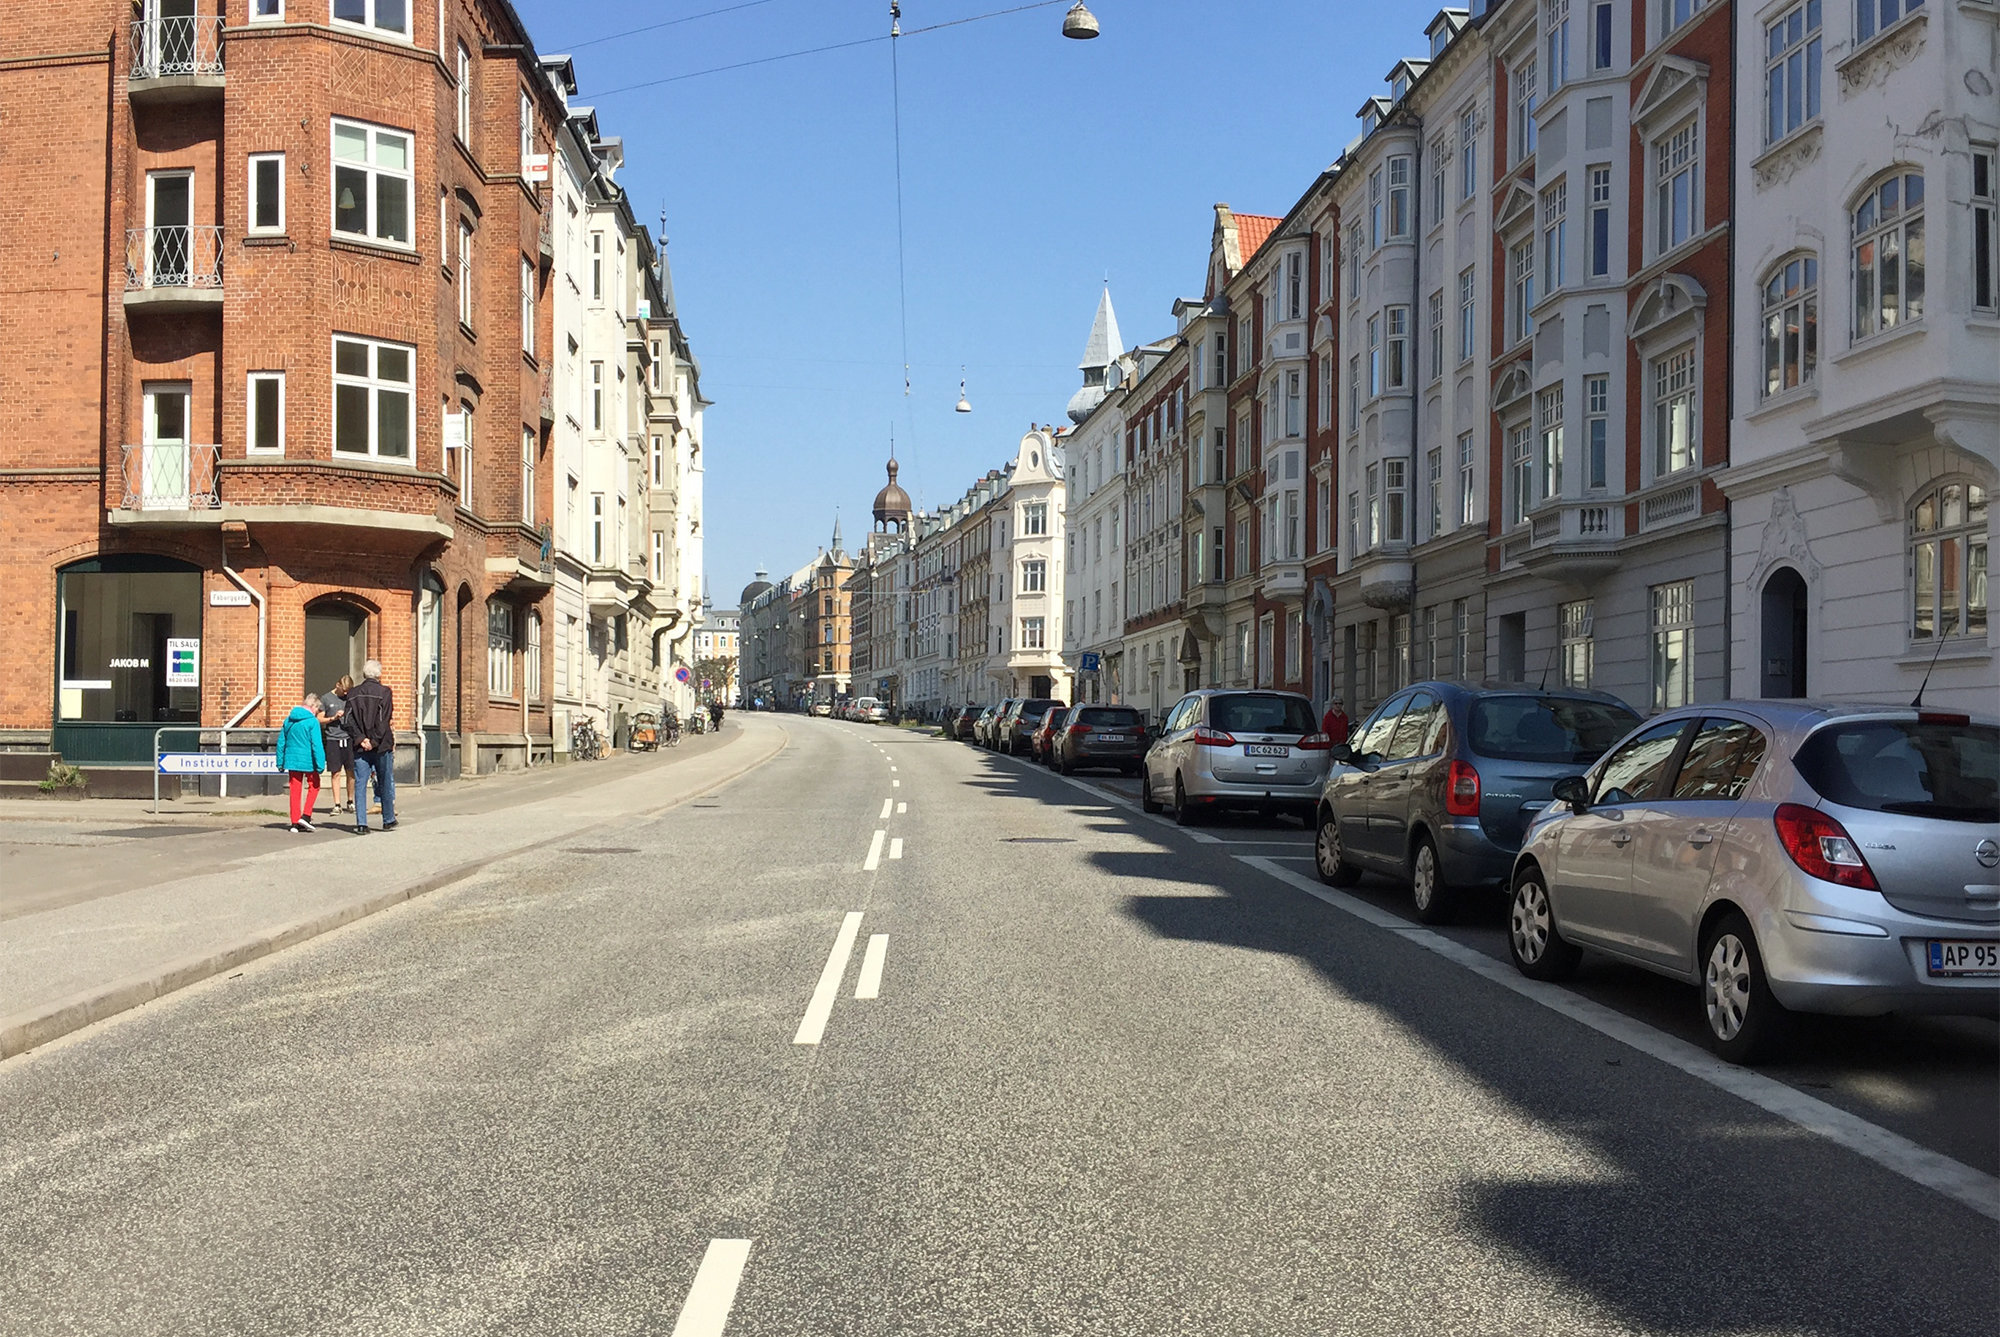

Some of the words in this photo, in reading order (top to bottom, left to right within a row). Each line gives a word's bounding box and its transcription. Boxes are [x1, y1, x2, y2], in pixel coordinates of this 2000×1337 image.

[180, 640, 198, 648] SALG
[109, 658, 139, 668] JAKOB
[140, 658, 149, 668] M
[1084, 655, 1096, 668] P
[1250, 745, 1261, 754] BC
[1262, 746, 1272, 754] 62
[1273, 747, 1287, 755] 623
[180, 757, 229, 768] Institut
[234, 757, 253, 768] for
[1945, 945, 1969, 966] AP
[1975, 945, 1997, 966] 95
